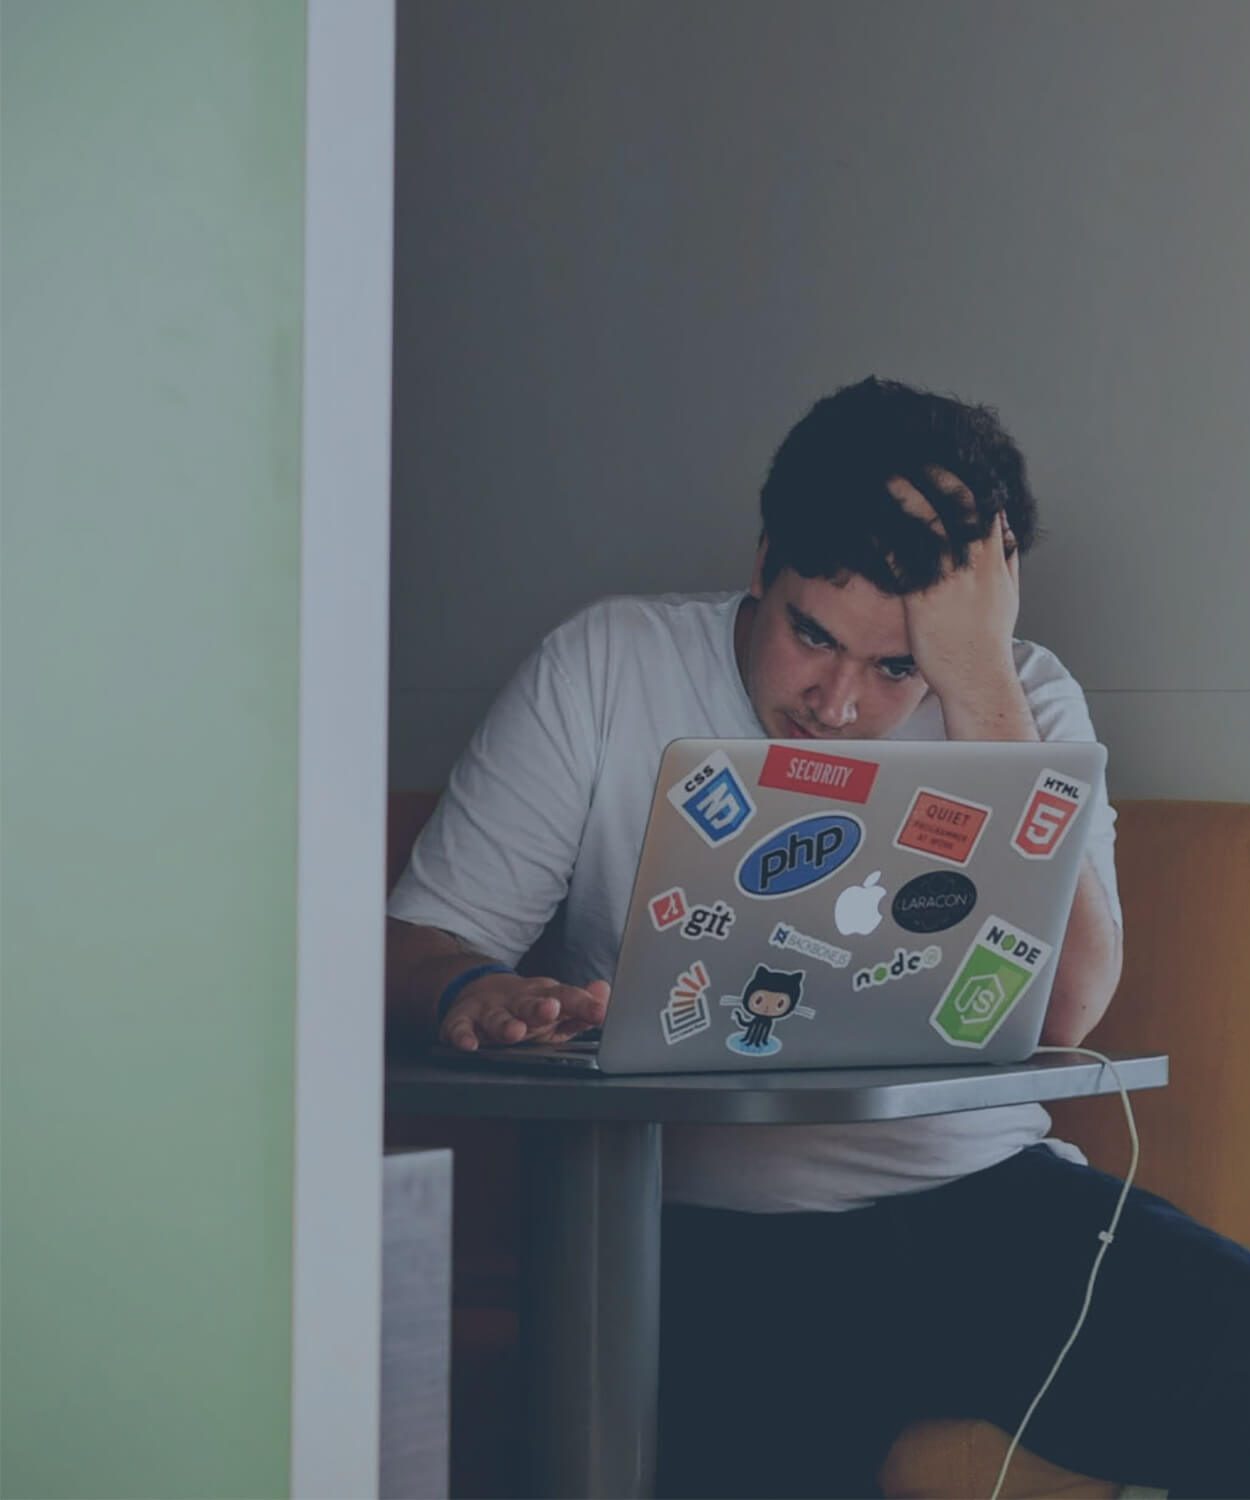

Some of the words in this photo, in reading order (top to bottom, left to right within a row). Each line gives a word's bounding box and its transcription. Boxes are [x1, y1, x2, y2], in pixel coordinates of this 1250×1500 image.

[684, 765, 714, 793] CSS
[787, 758, 854, 787] SECURITY
[1044, 776, 1080, 799] HTML
[696, 782, 741, 829] 3
[926, 804, 972, 826] QUIET
[1025, 803, 1066, 844] 5
[760, 827, 843, 890] php
[902, 893, 969, 911] LARACON
[684, 905, 733, 936] git
[986, 926, 1042, 965] NODE
[955, 986, 996, 1013] JS
